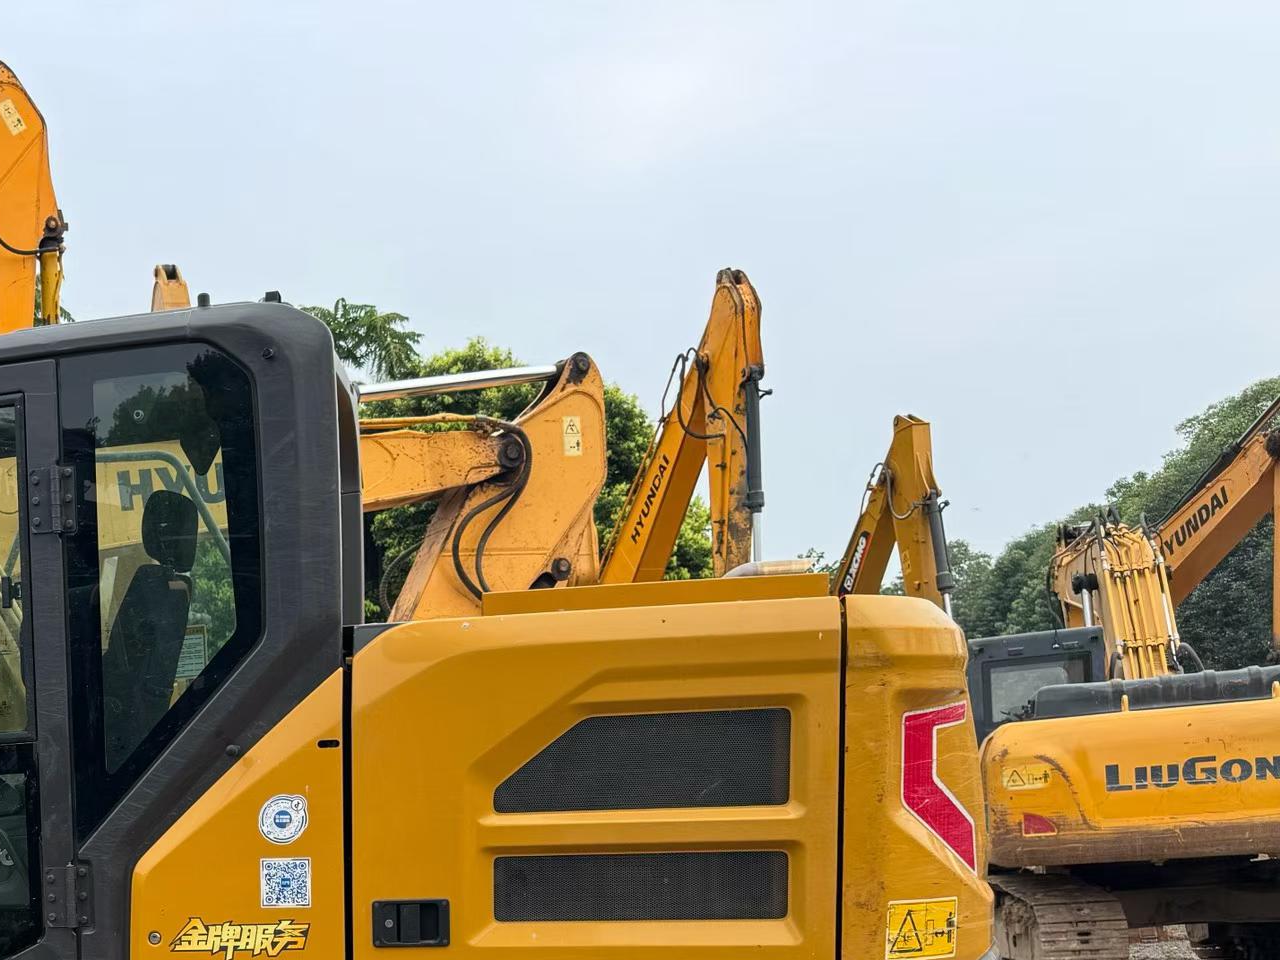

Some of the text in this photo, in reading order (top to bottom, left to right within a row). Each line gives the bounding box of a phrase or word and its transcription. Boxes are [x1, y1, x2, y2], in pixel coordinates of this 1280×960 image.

[116, 462, 226, 512] HYU
[630, 454, 670, 545] HYUNDAI
[1163, 485, 1229, 556] YUNDAI
[1105, 755, 1280, 792] LIUGON
